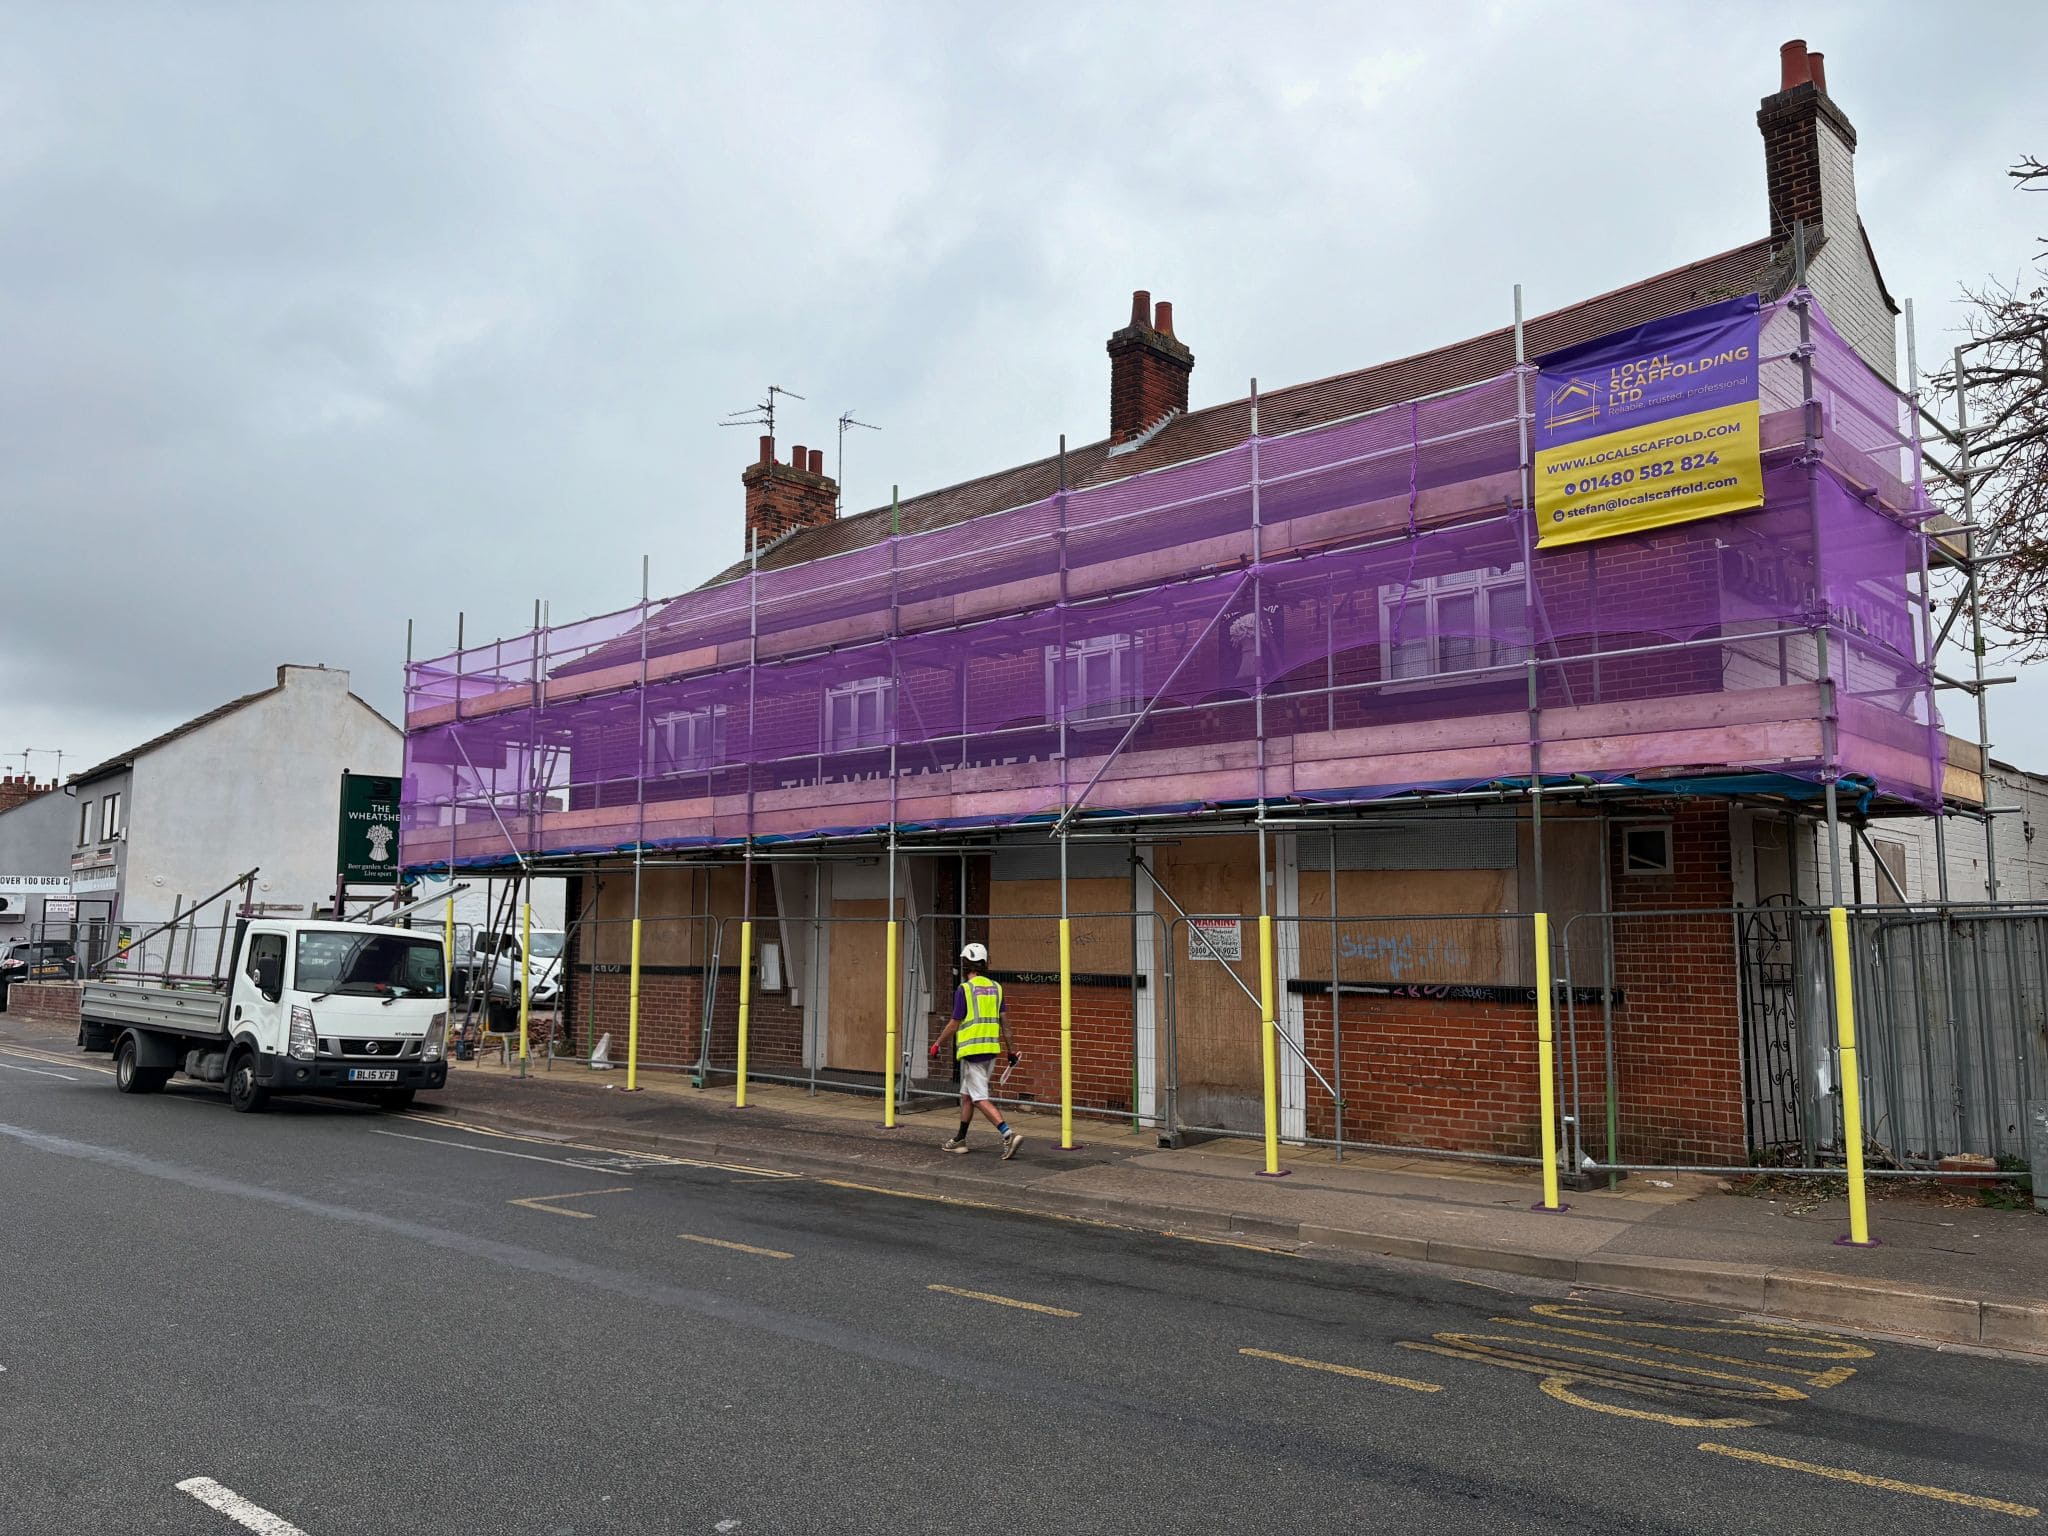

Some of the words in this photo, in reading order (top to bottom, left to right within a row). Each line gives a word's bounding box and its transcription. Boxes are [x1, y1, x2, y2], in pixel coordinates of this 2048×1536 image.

[1609, 346, 1749, 392] SCAFFOLDING
[1611, 354, 1674, 379] LOCAL
[1609, 388, 1643, 407] LTD
[1687, 376, 1748, 399] professional
[1547, 422, 1741, 475] WWW.LOCALSCAFFOLD.COM
[1579, 469, 1635, 493] 01480
[1639, 460, 1675, 481] 582
[1680, 450, 1720, 472] 824
[1567, 475, 1738, 518] stefan@localscaffold.com
[372, 804, 391, 813] THE
[0, 876, 21, 886] OVER
[24, 877, 38, 886] 100
[40, 877, 61, 886] USED
[357, 1071, 377, 1080] BL15
[378, 1071, 396, 1080] XFB
